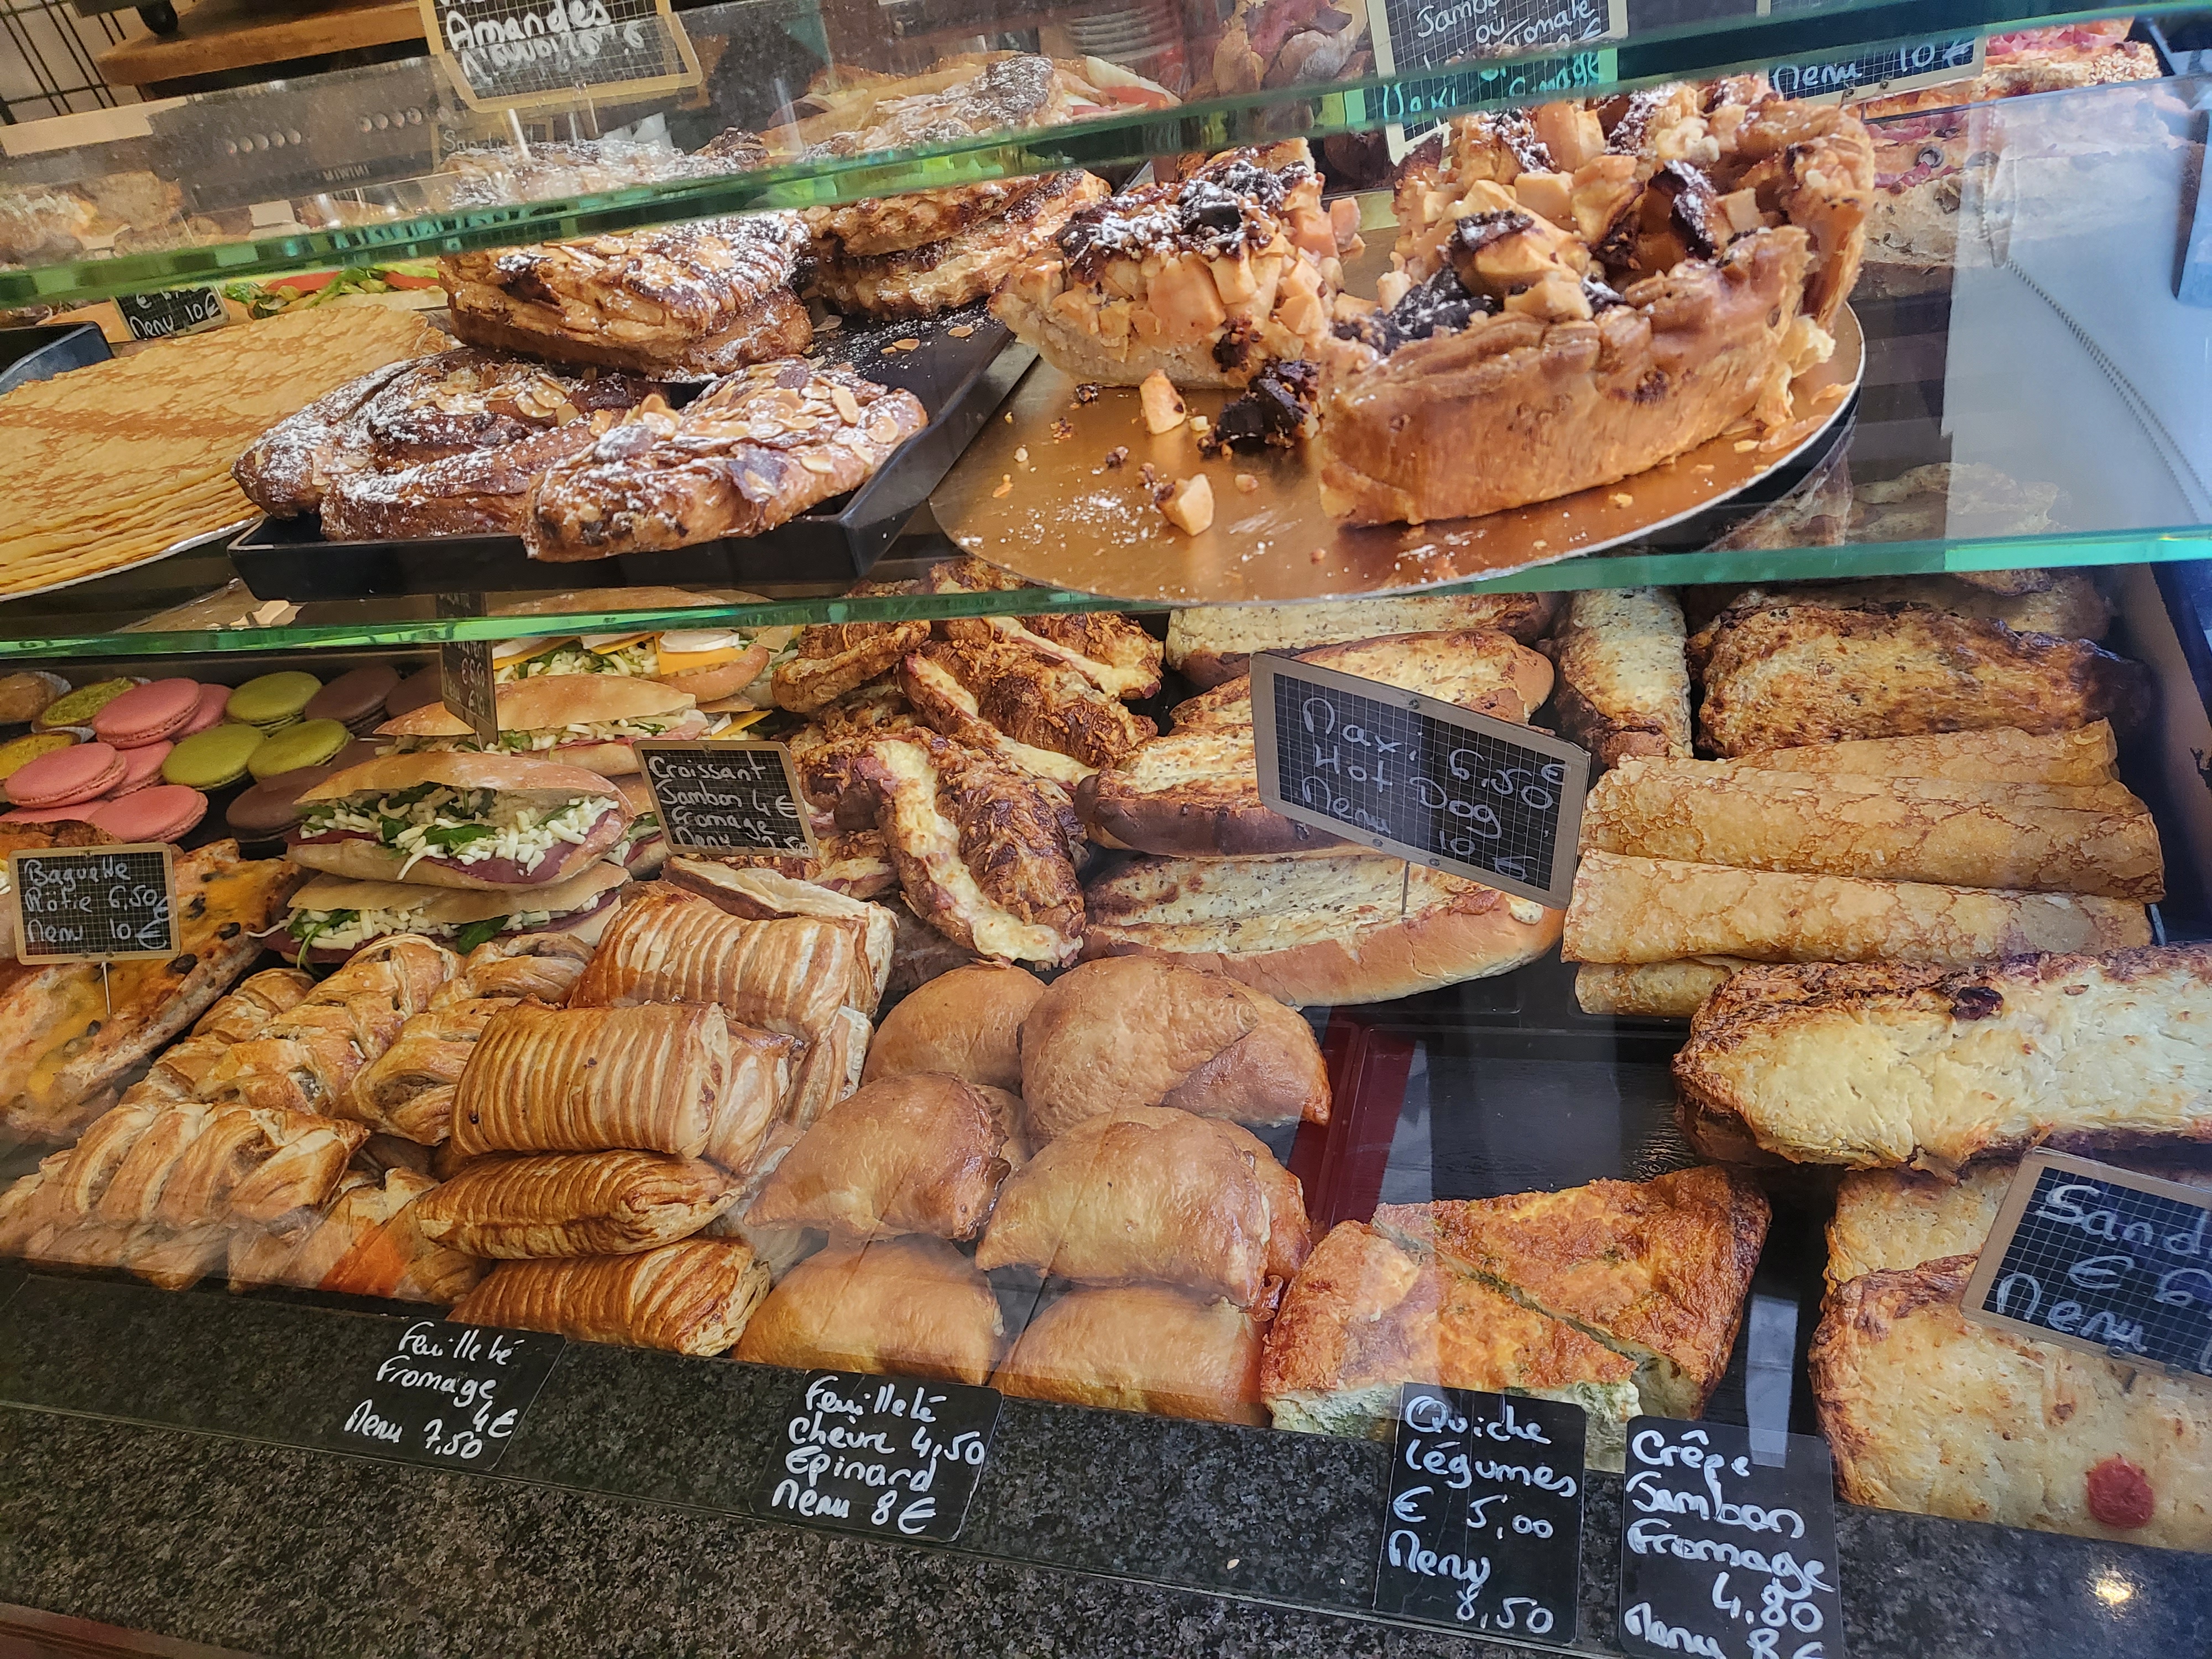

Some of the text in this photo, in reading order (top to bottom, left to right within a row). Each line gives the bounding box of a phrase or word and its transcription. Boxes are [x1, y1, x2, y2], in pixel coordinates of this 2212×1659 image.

[446, 0, 612, 51] Amandes
[648, 750, 766, 781] Croissant
[1315, 743, 1503, 839] Hot Dog
[655, 779, 743, 808] Jambon
[1302, 775, 1392, 834] Menu
[671, 805, 776, 841] Fromage
[28, 919, 83, 943] Menu
[2034, 1184, 2212, 1259] Sand
[1996, 1272, 2148, 1353] Menu
[375, 1354, 497, 1408] Fromage
[343, 1399, 403, 1443] Menu
[1405, 1395, 1552, 1444] Quiche
[771, 1478, 851, 1519] Menu
[1626, 1470, 1806, 1539] Jambon
[1627, 1517, 1837, 1601] Fromage
